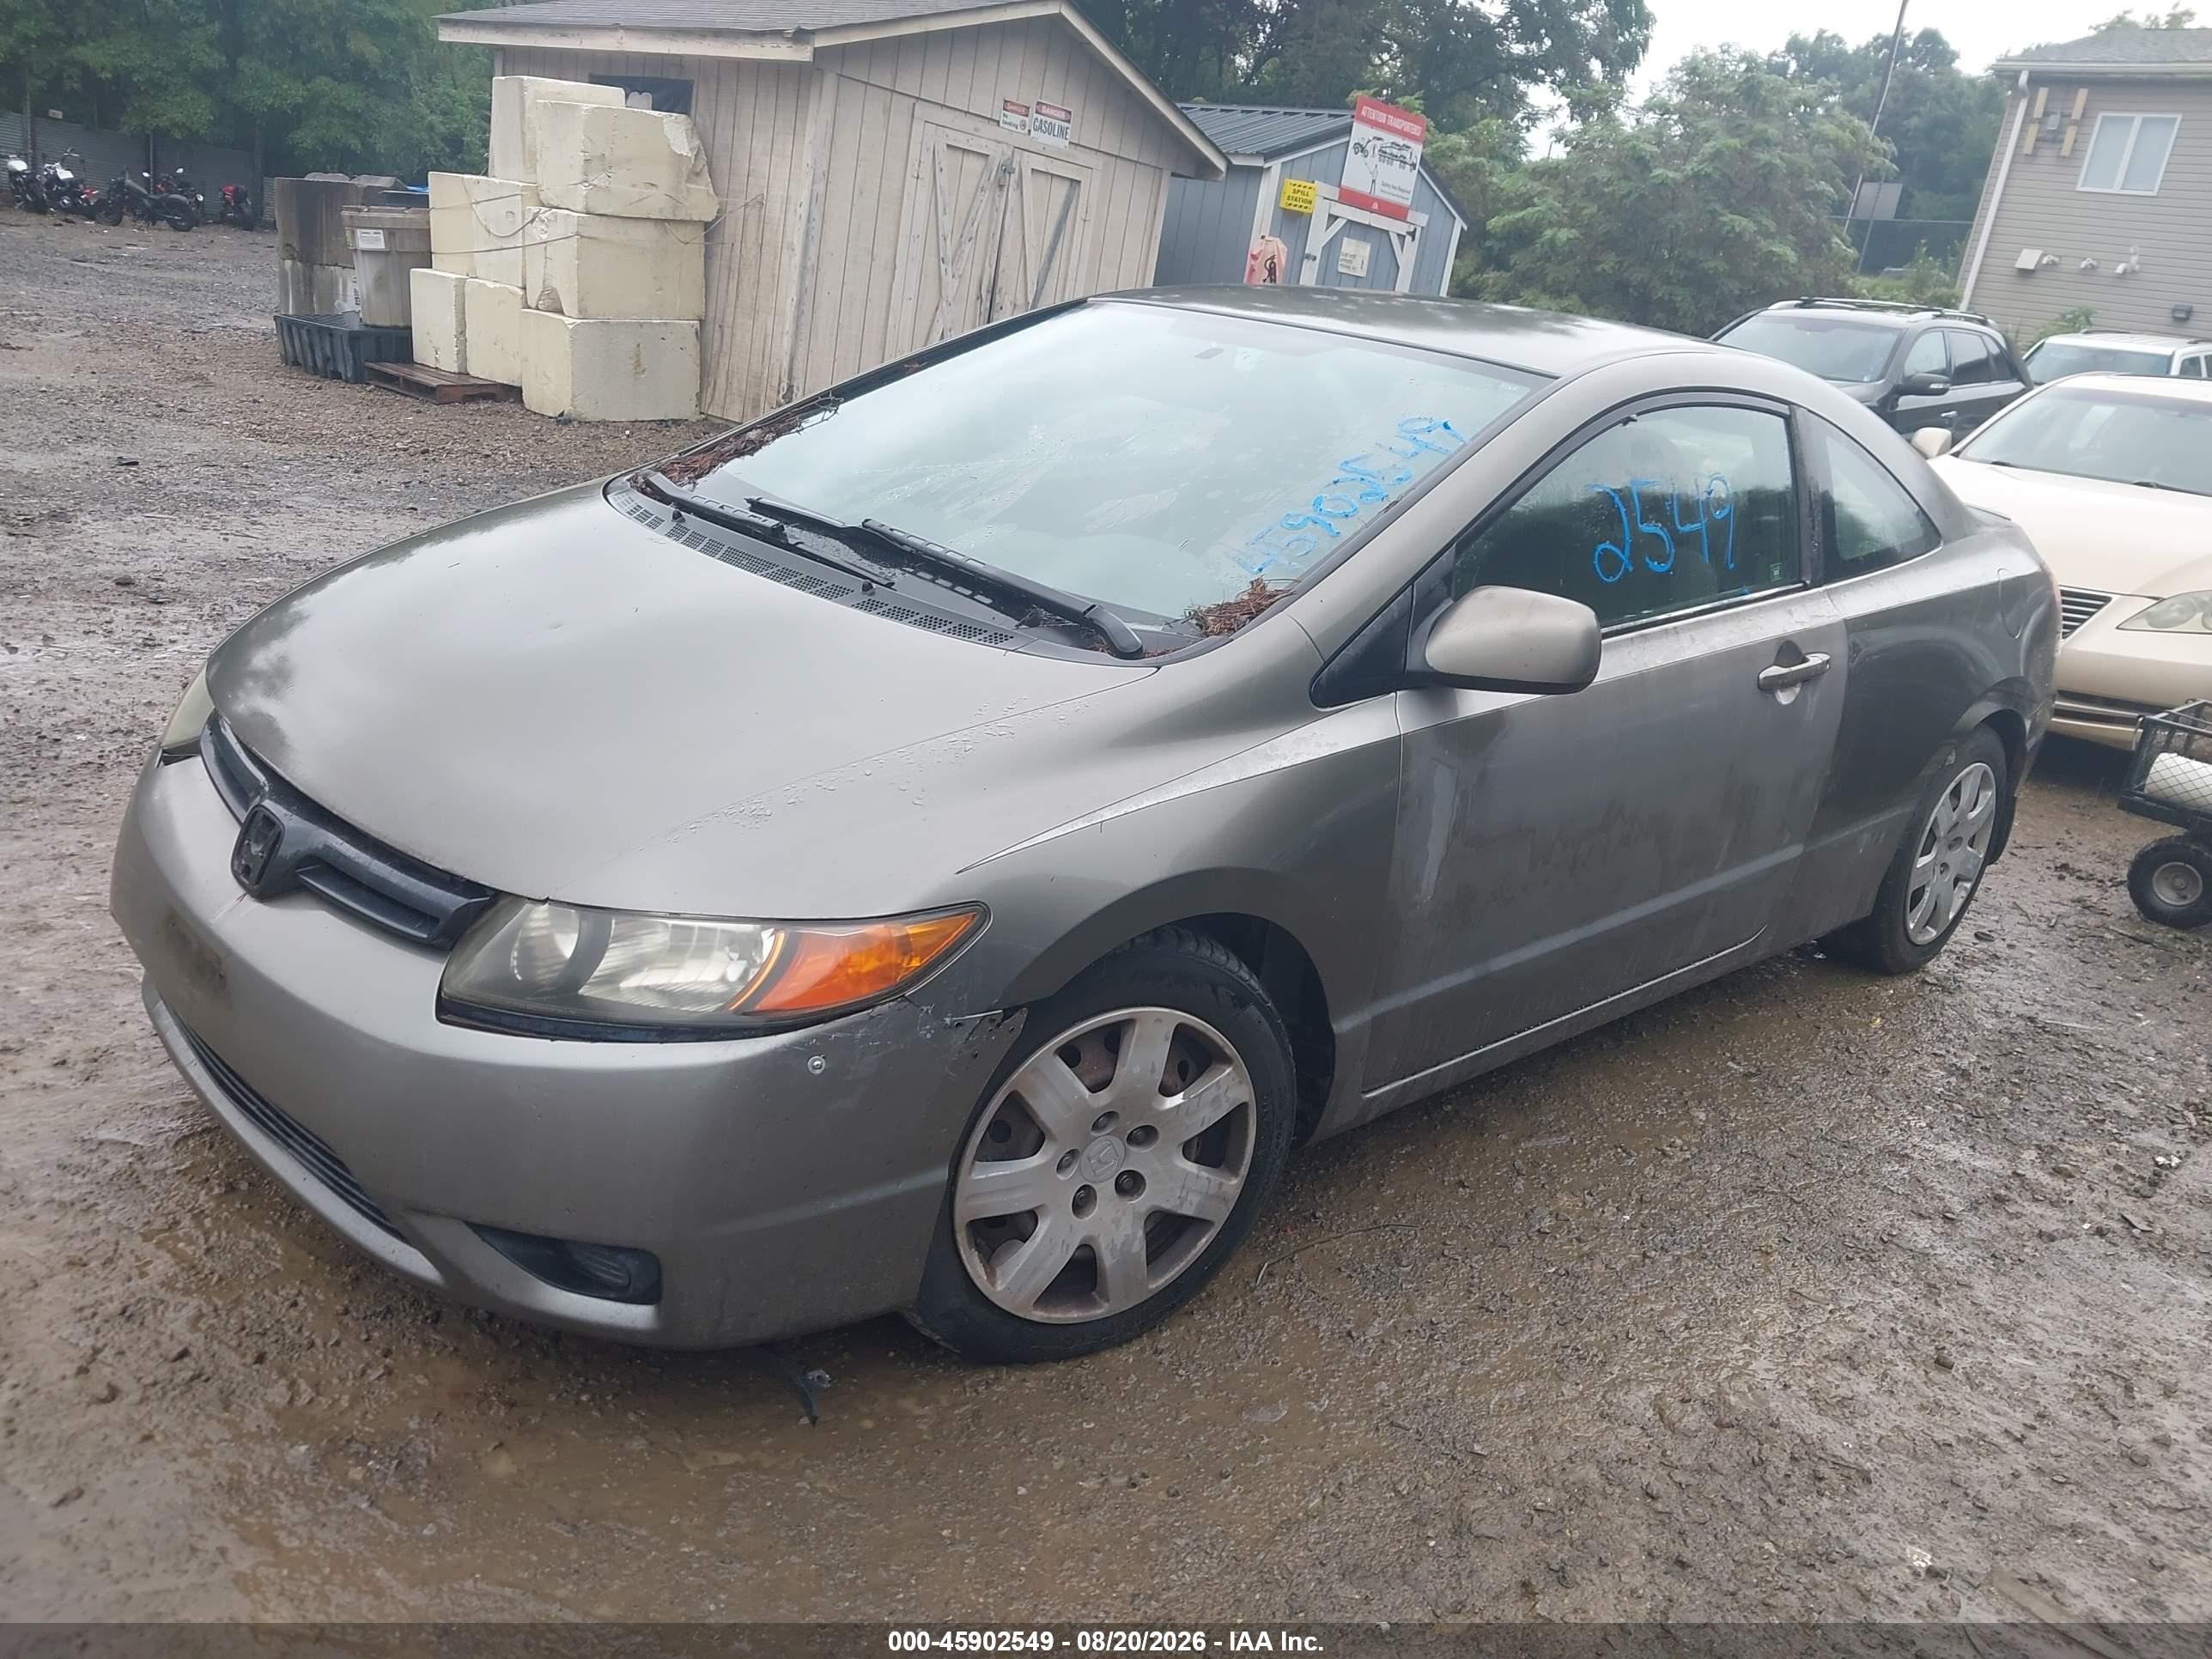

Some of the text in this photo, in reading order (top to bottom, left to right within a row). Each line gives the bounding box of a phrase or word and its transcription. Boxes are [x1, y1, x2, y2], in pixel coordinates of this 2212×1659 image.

[1033, 118, 1070, 141] GASOLINE
[1286, 195, 1313, 205] STATION
[1292, 188, 1310, 197] SPILL
[1585, 473, 1735, 582] 2549
